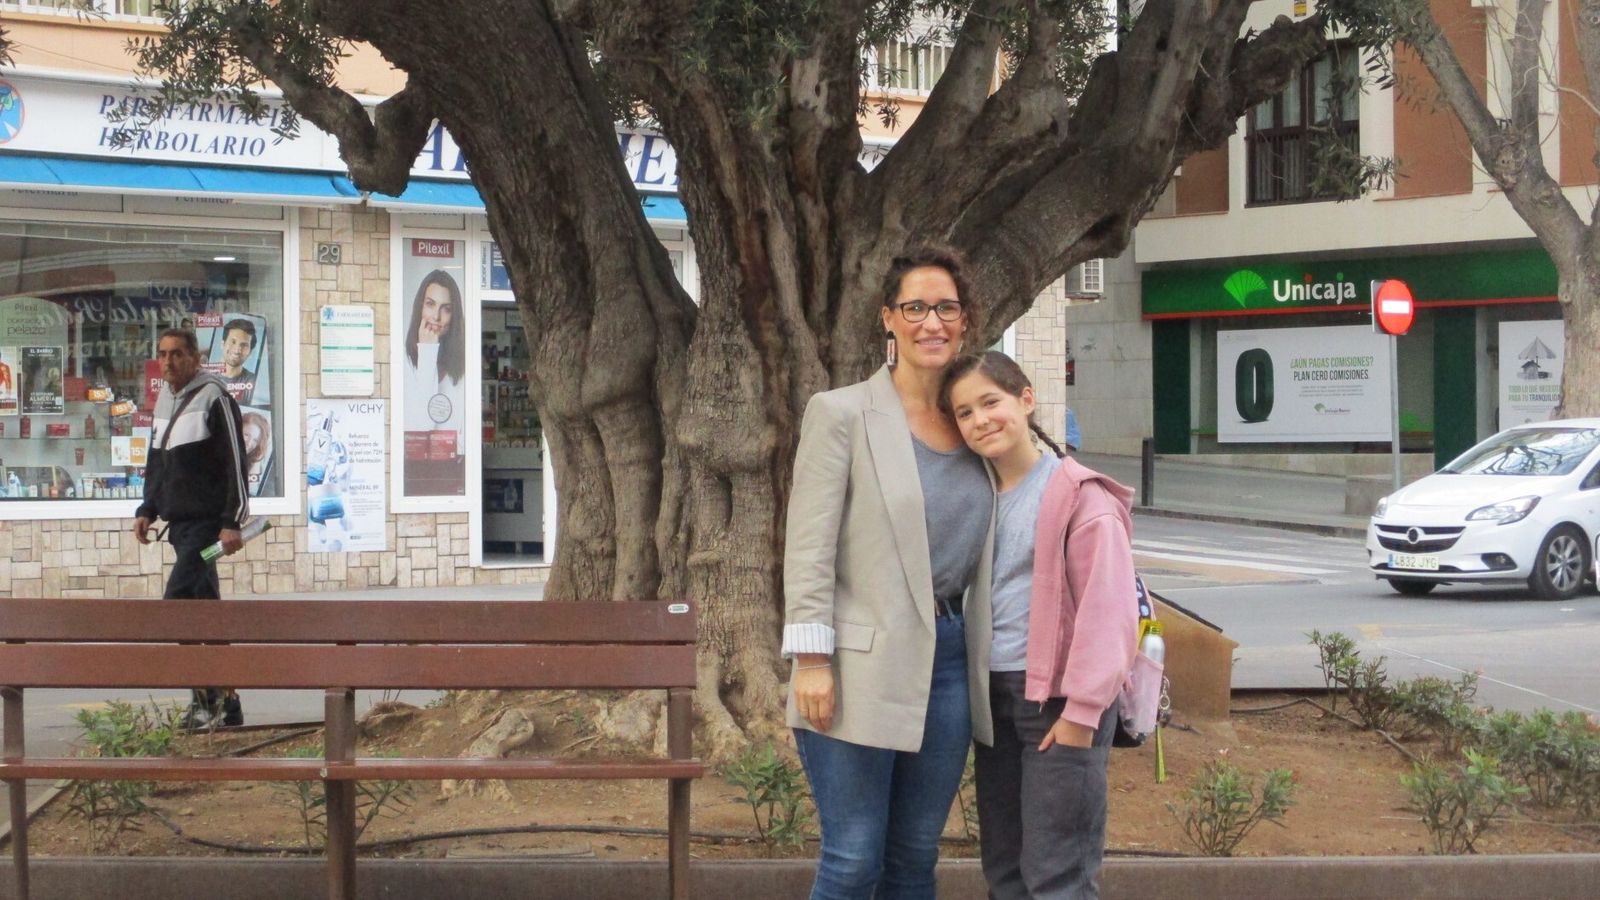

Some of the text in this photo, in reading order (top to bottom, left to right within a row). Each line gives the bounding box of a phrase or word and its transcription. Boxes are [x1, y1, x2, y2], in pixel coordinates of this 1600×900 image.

[319, 244, 340, 263] 29
[418, 241, 450, 255] Pilexil
[1273, 272, 1356, 304] Unicaja
[1309, 358, 1329, 368] PAGAS
[1331, 356, 1373, 367] COMISIONES?
[1294, 371, 1310, 381] PLAN
[1312, 371, 1328, 380] CERO
[348, 403, 383, 413] VICHY
